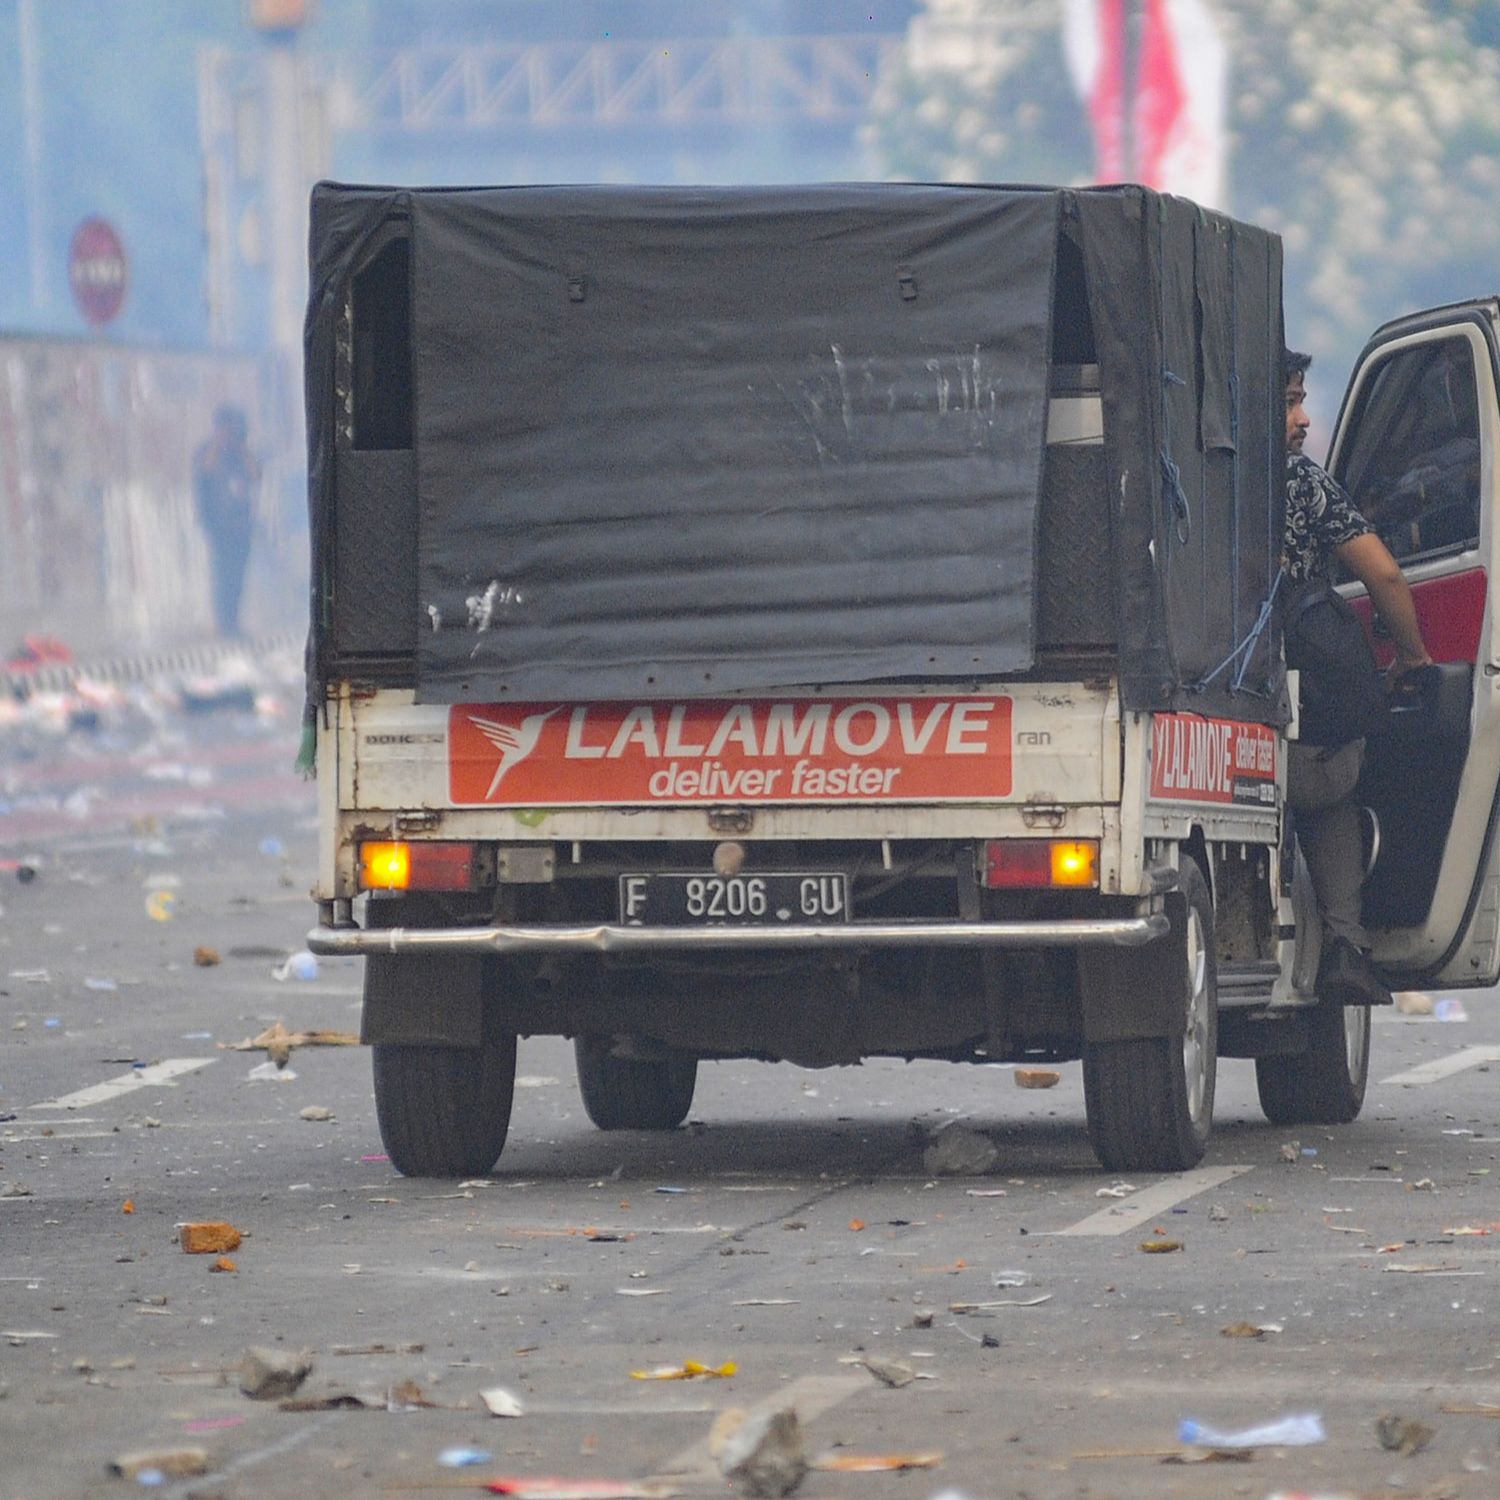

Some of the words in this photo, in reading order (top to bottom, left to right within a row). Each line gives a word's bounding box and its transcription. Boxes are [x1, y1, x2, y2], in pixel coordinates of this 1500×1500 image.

[564, 702, 995, 759] LALAMOVE
[648, 761, 783, 797] deliver
[790, 759, 901, 795] faster
[1163, 718, 1232, 793] LALAMOVE
[626, 878, 647, 917] F
[686, 878, 767, 917] 8206
[800, 877, 843, 916] GU
